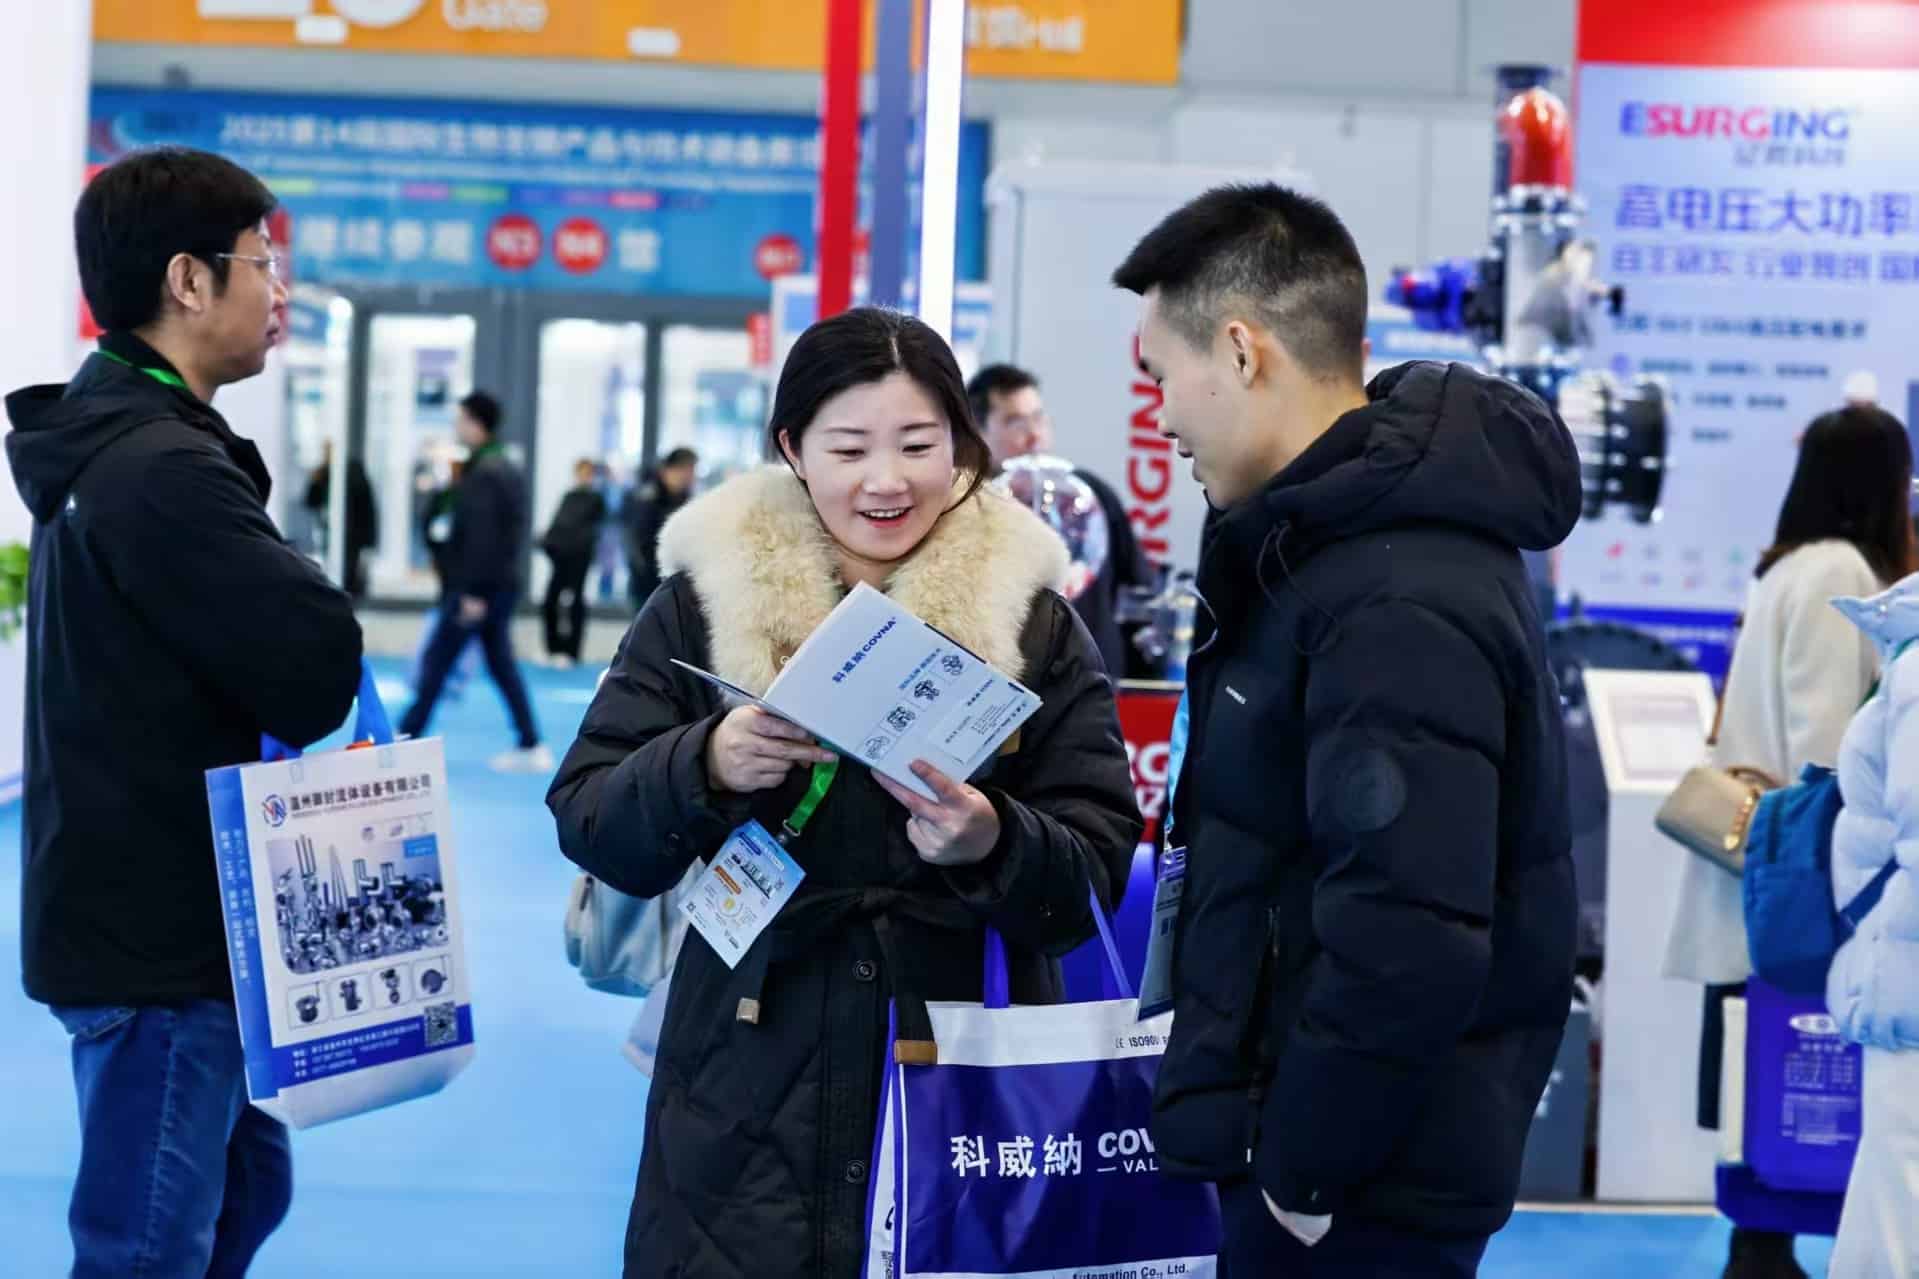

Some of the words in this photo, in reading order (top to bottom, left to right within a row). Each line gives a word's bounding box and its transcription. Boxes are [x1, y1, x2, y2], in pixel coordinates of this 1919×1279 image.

[1619, 101, 1850, 140] ESURGING
[1616, 184, 1914, 236] 高电压大功率
[862, 619, 896, 653] COVNA
[951, 1134, 1083, 1178] 科威納
[1167, 1263, 1190, 1276] Ltd.
